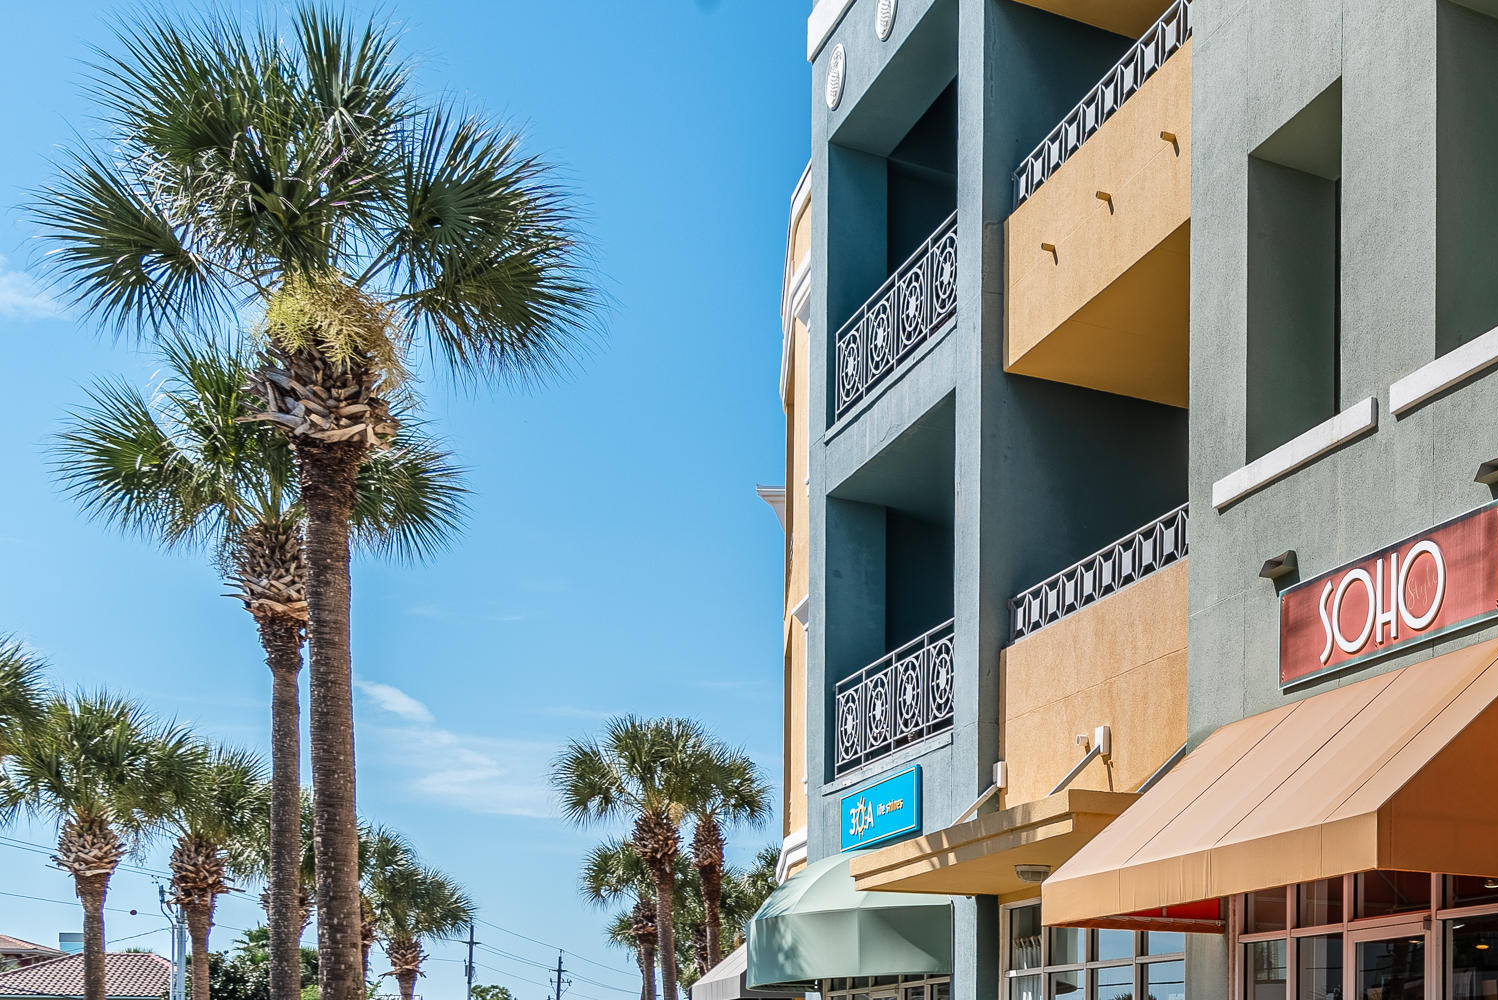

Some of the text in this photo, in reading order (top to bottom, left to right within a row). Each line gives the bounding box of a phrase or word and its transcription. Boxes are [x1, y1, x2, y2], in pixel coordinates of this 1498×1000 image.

[1318, 540, 1446, 664] SOHO
[1407, 561, 1438, 610] Style
[849, 798, 874, 838] 30A
[876, 803, 886, 816] life
